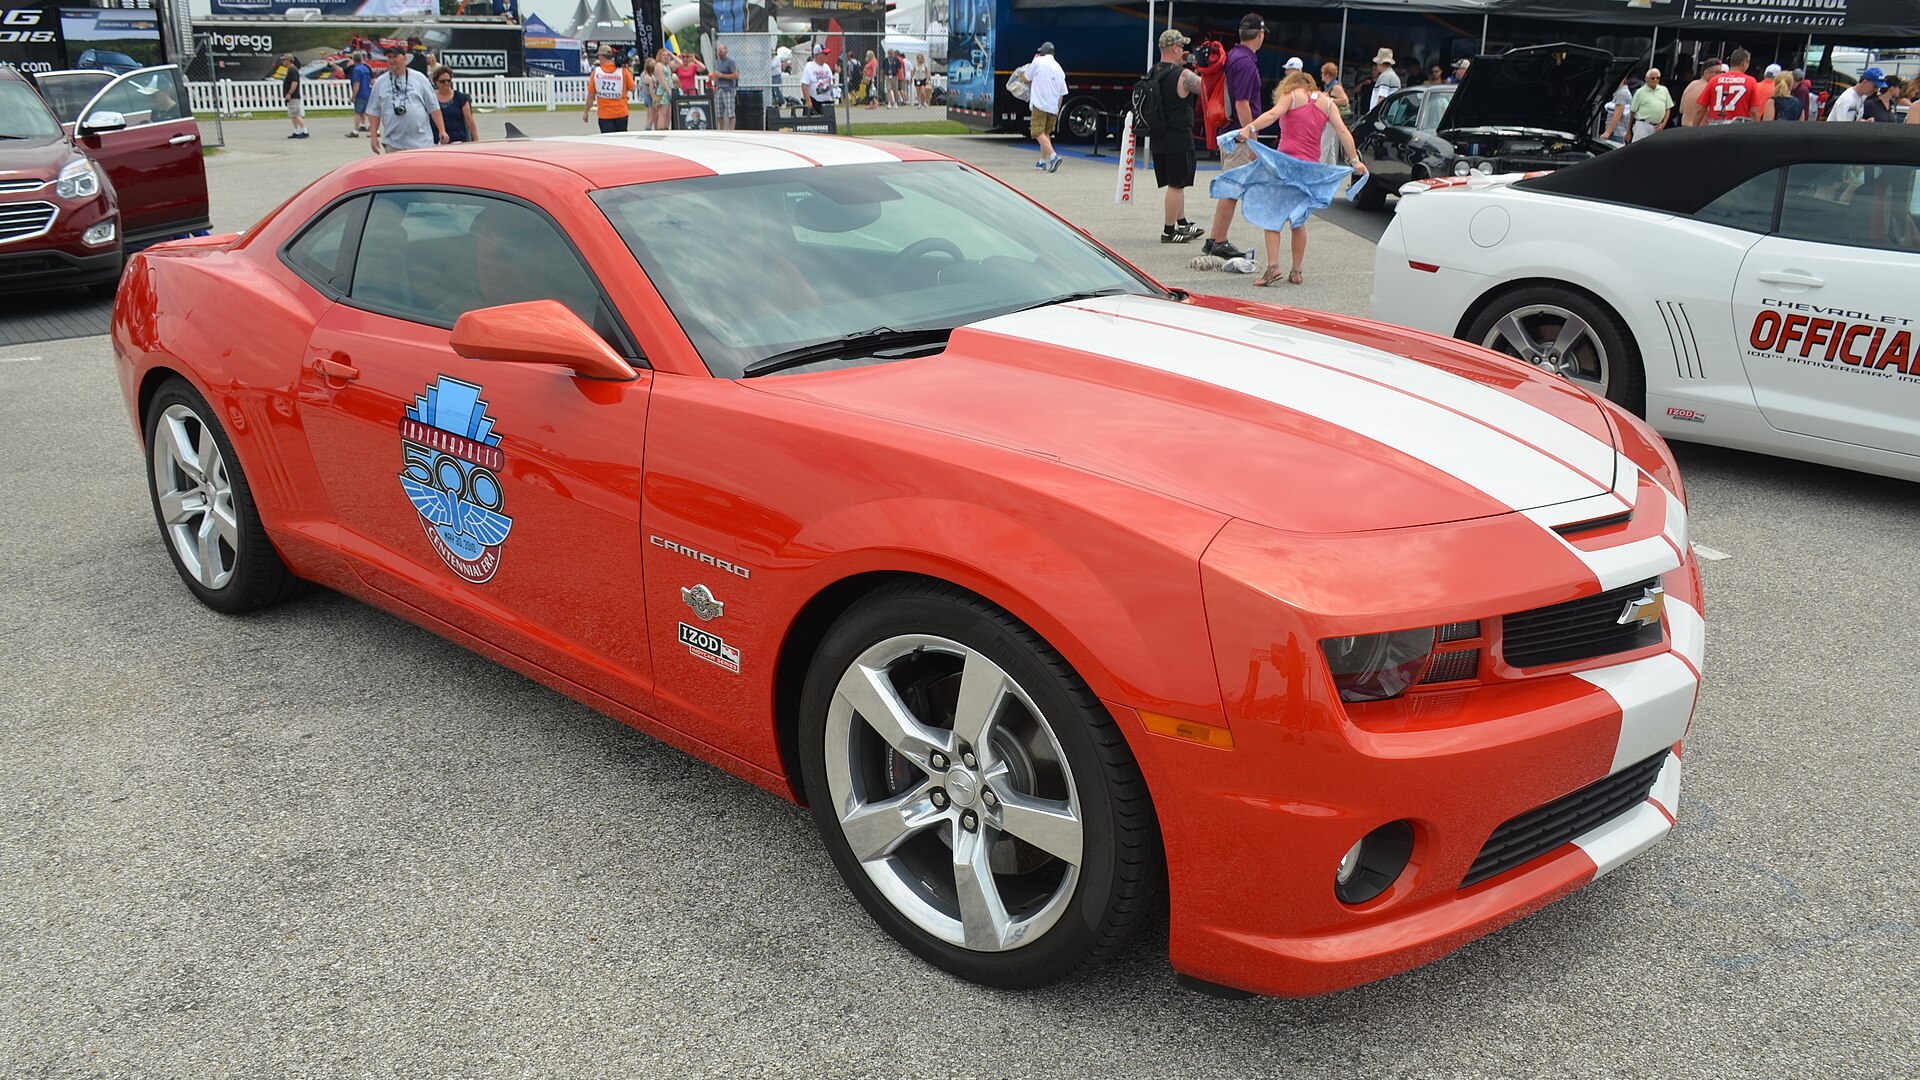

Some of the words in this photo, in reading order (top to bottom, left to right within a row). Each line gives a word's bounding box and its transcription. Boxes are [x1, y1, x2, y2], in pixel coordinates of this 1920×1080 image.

[0, 9, 43, 25] G
[1693, 10, 1748, 22] VEHICLES
[1758, 14, 1791, 25] PARTS
[1802, 16, 1845, 27] RACING
[443, 54, 505, 67] MAYTAG
[596, 73, 621, 81] Canon
[602, 80, 616, 91] 222
[1713, 85, 1747, 112] 17
[1761, 298, 1914, 326] CHEVROLET
[1787, 357, 1893, 379] ANNIVERSARY
[1668, 408, 1693, 417] IZOD
[403, 420, 498, 468] INDIANAPOLIS
[402, 438, 505, 513] 500
[428, 526, 484, 577] CENTENNIAL
[480, 551, 496, 574] ERA
[650, 534, 750, 579] CAMARO
[682, 626, 719, 652] IZOD
[716, 657, 738, 671] SERIES
[888, 746, 896, 790] CHEVROL
